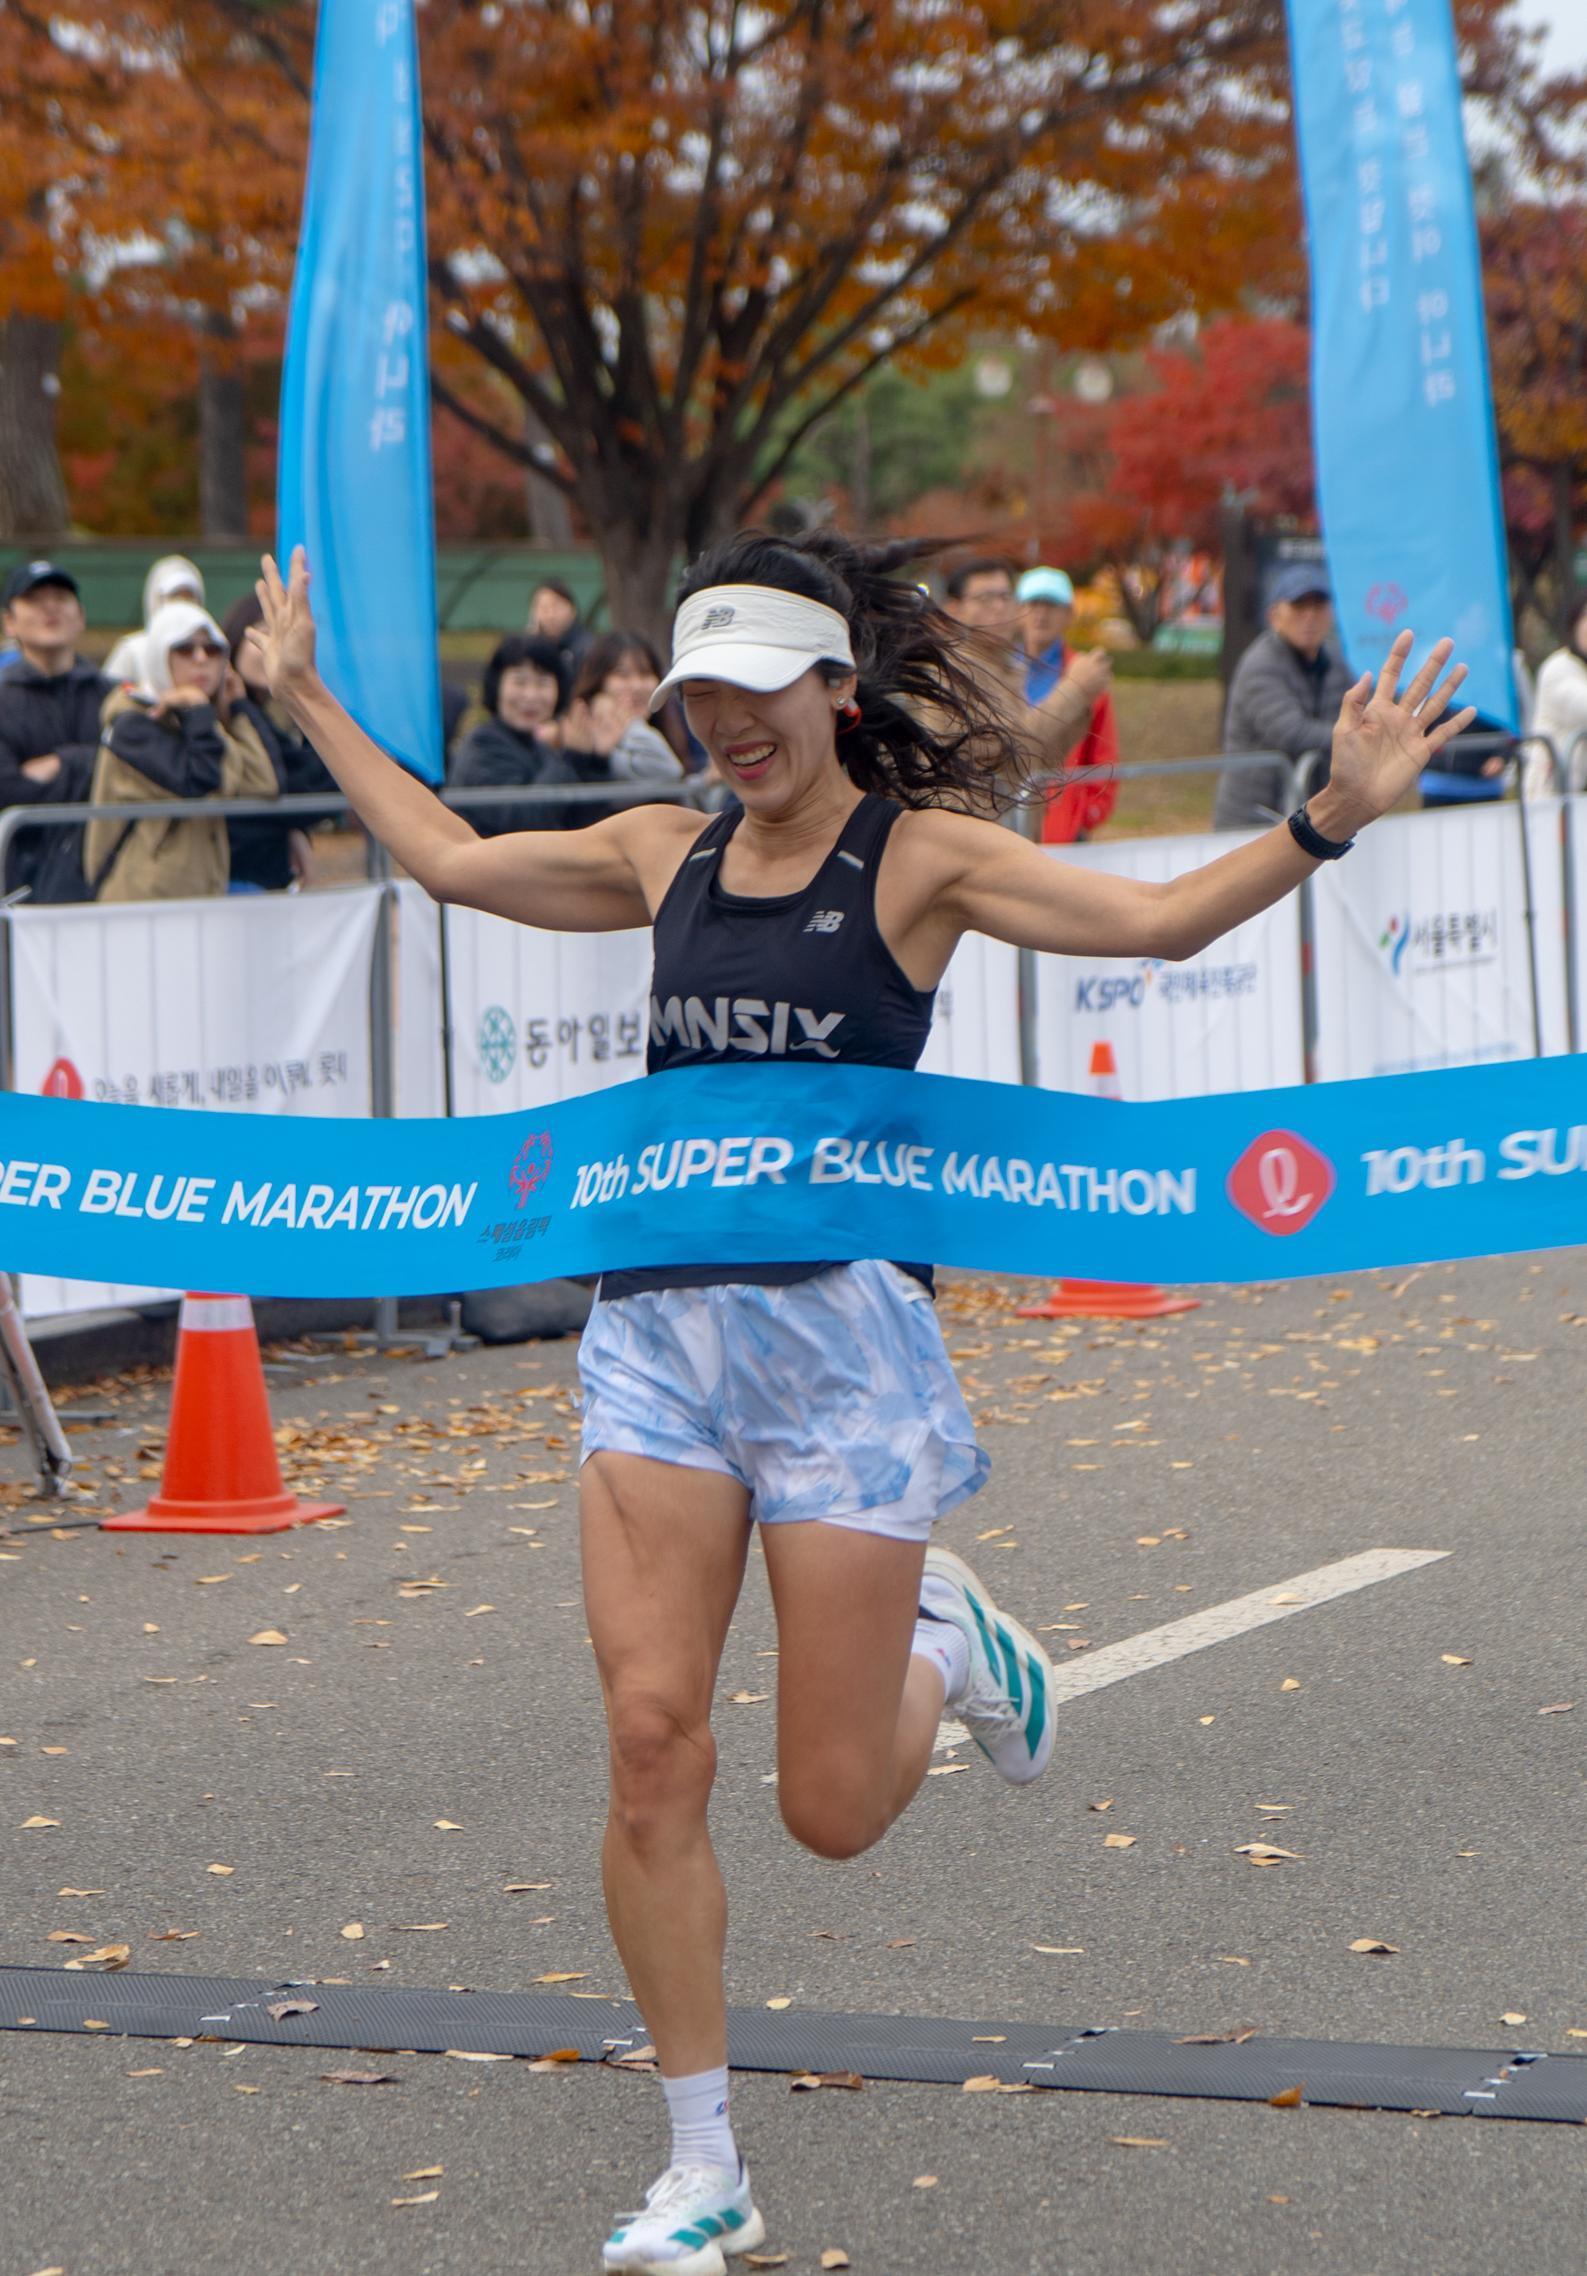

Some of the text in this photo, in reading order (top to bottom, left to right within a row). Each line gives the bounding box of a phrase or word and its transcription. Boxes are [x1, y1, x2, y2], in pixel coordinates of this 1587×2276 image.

[526, 1012, 642, 1069] 동아일보
[570, 1137, 1196, 1216] 10th SUPER BLUE MARATHON
[1361, 1125, 1587, 1196] 10th SU
[80, 1169, 216, 1222] BLUE
[221, 1181, 478, 1230] MARATHON
